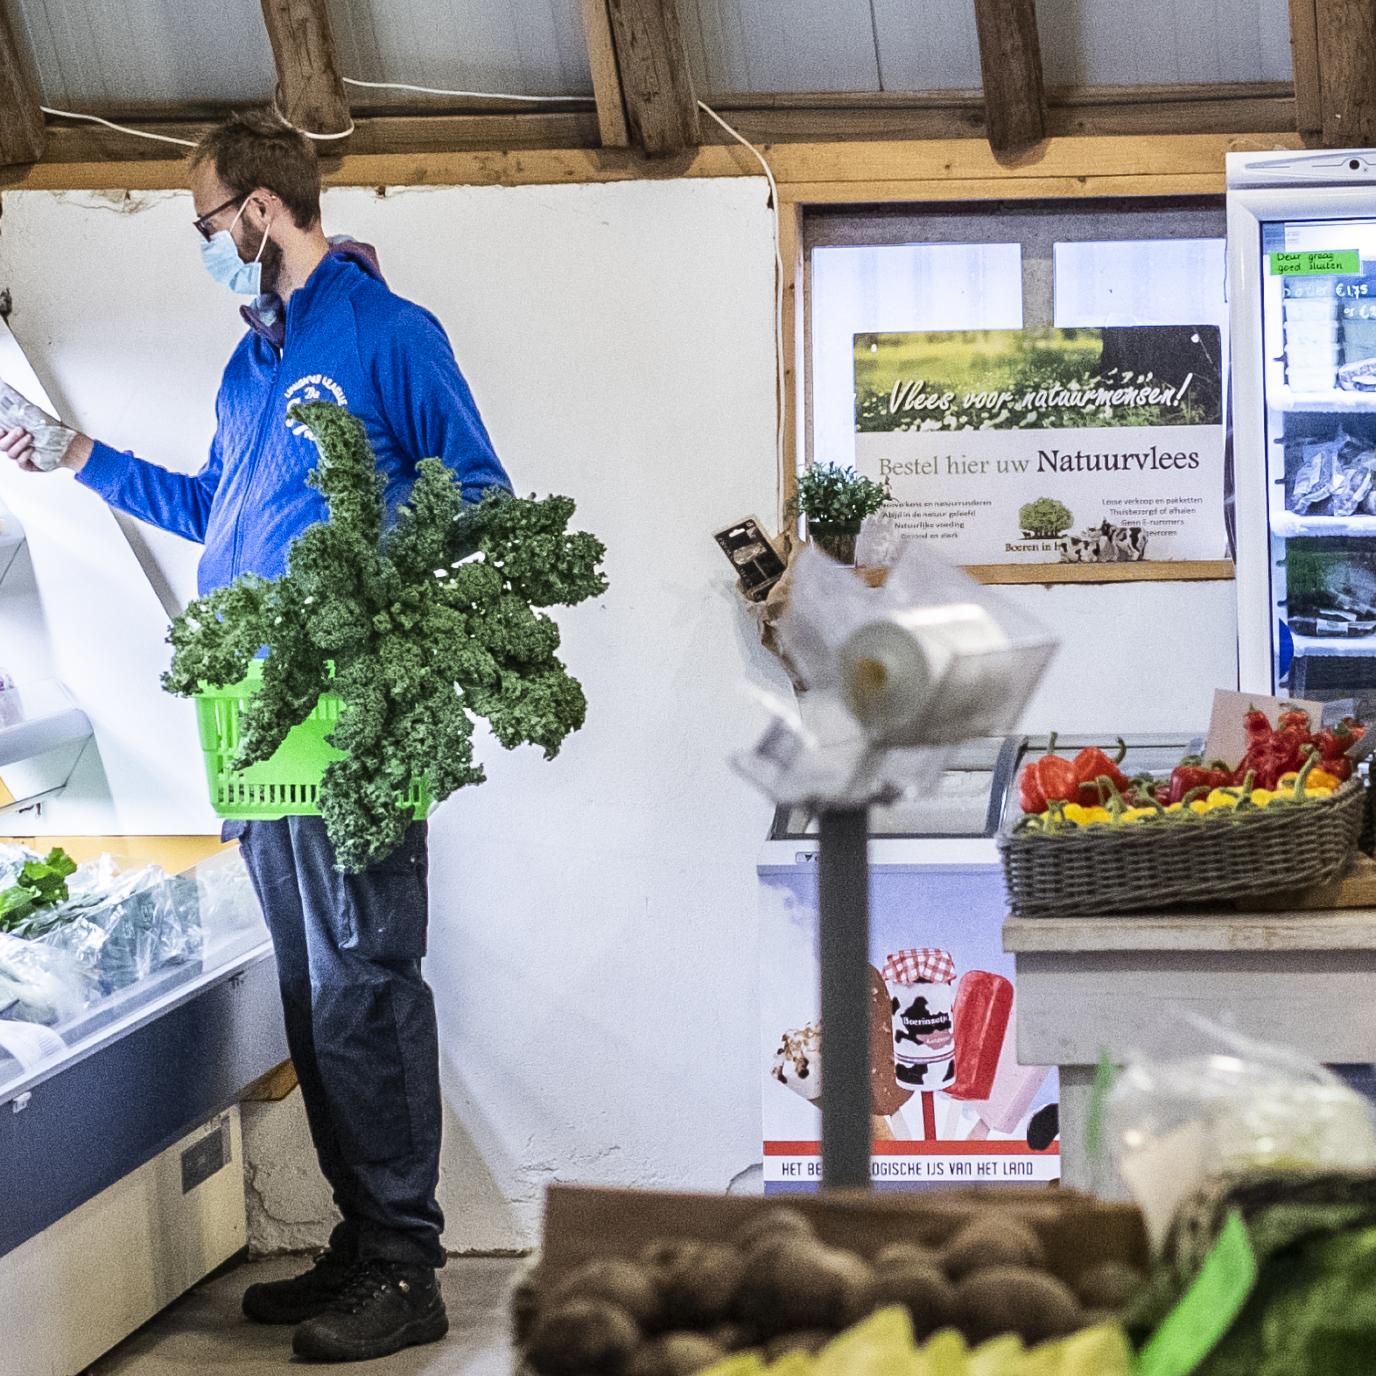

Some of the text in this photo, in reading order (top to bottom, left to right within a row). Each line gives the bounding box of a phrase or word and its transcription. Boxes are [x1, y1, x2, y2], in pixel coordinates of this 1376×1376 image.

[1277, 264, 1302, 275] goed
[889, 371, 1193, 414] Vlees voor natuurmensen!
[879, 445, 1200, 475] Bestel hier uw Natuurvlees
[1005, 542, 1039, 553] Boeren
[1042, 542, 1052, 552] in
[782, 1161, 803, 1176] HET
[927, 1161, 945, 1176] IJS
[949, 1161, 973, 1176] VAN
[977, 1161, 999, 1176] HET
[1003, 1161, 1034, 1176] LAND
